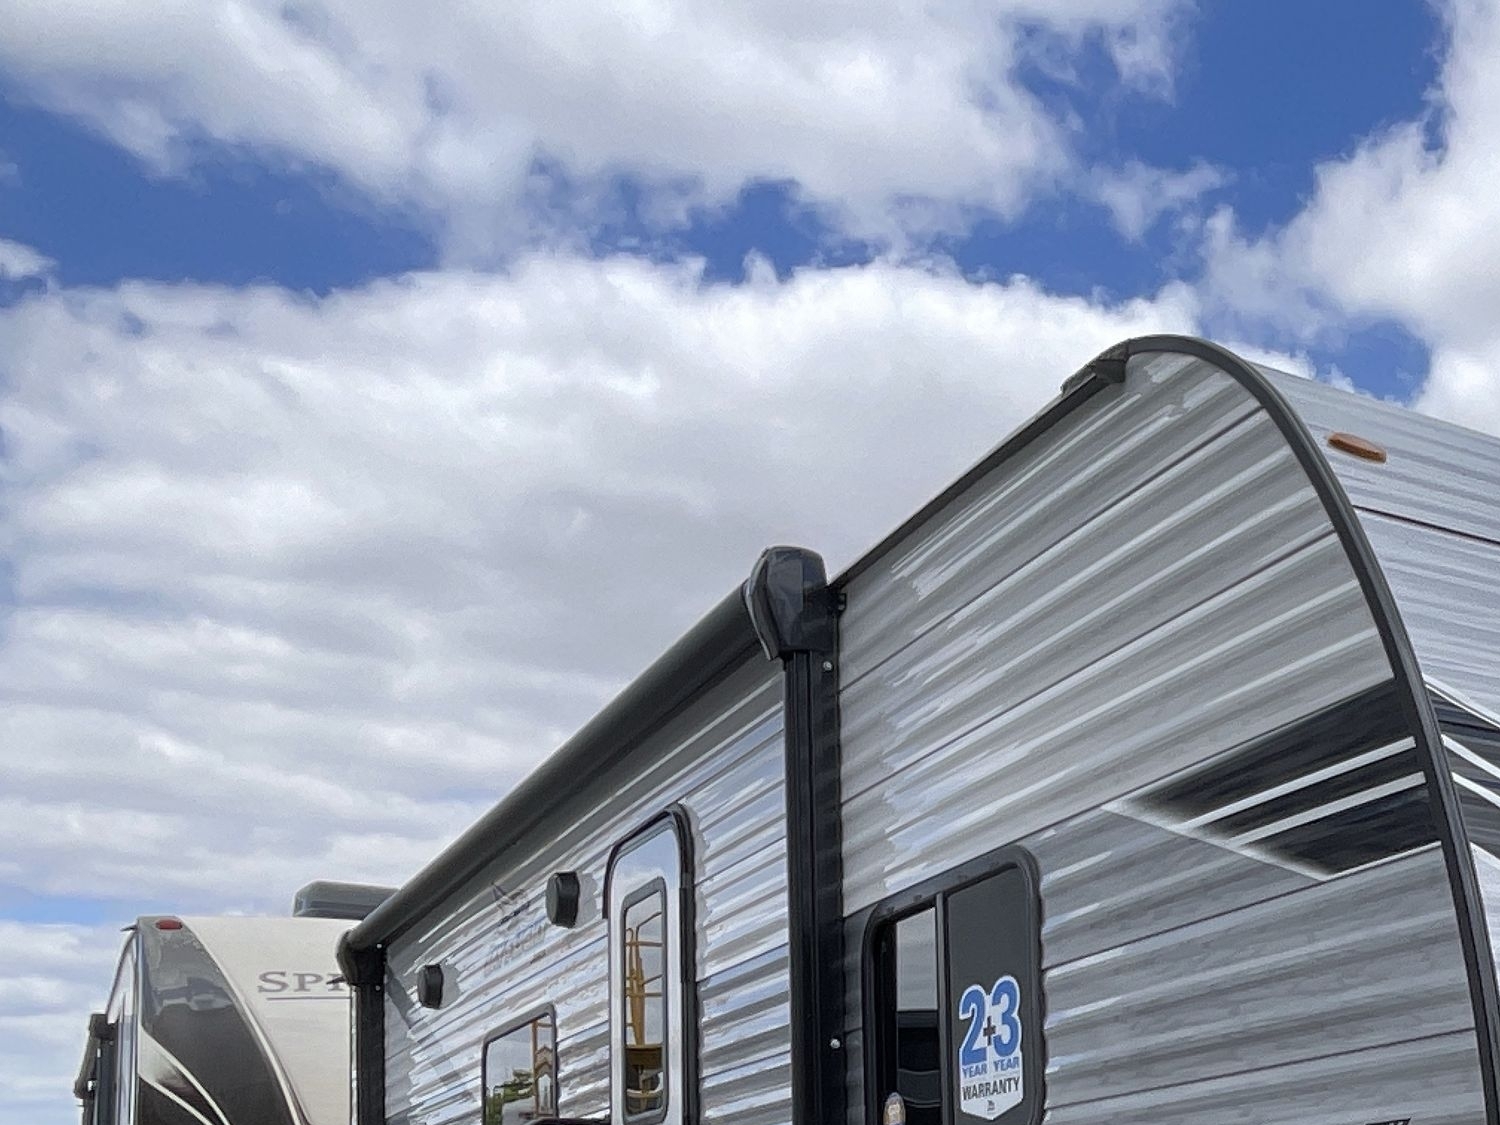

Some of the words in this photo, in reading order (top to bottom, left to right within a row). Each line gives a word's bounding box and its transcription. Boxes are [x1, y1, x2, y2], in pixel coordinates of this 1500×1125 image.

[963, 1065, 987, 1078] YEAR
[994, 1057, 1019, 1071] YEAR
[963, 1077, 1020, 1100] WARRANTY
